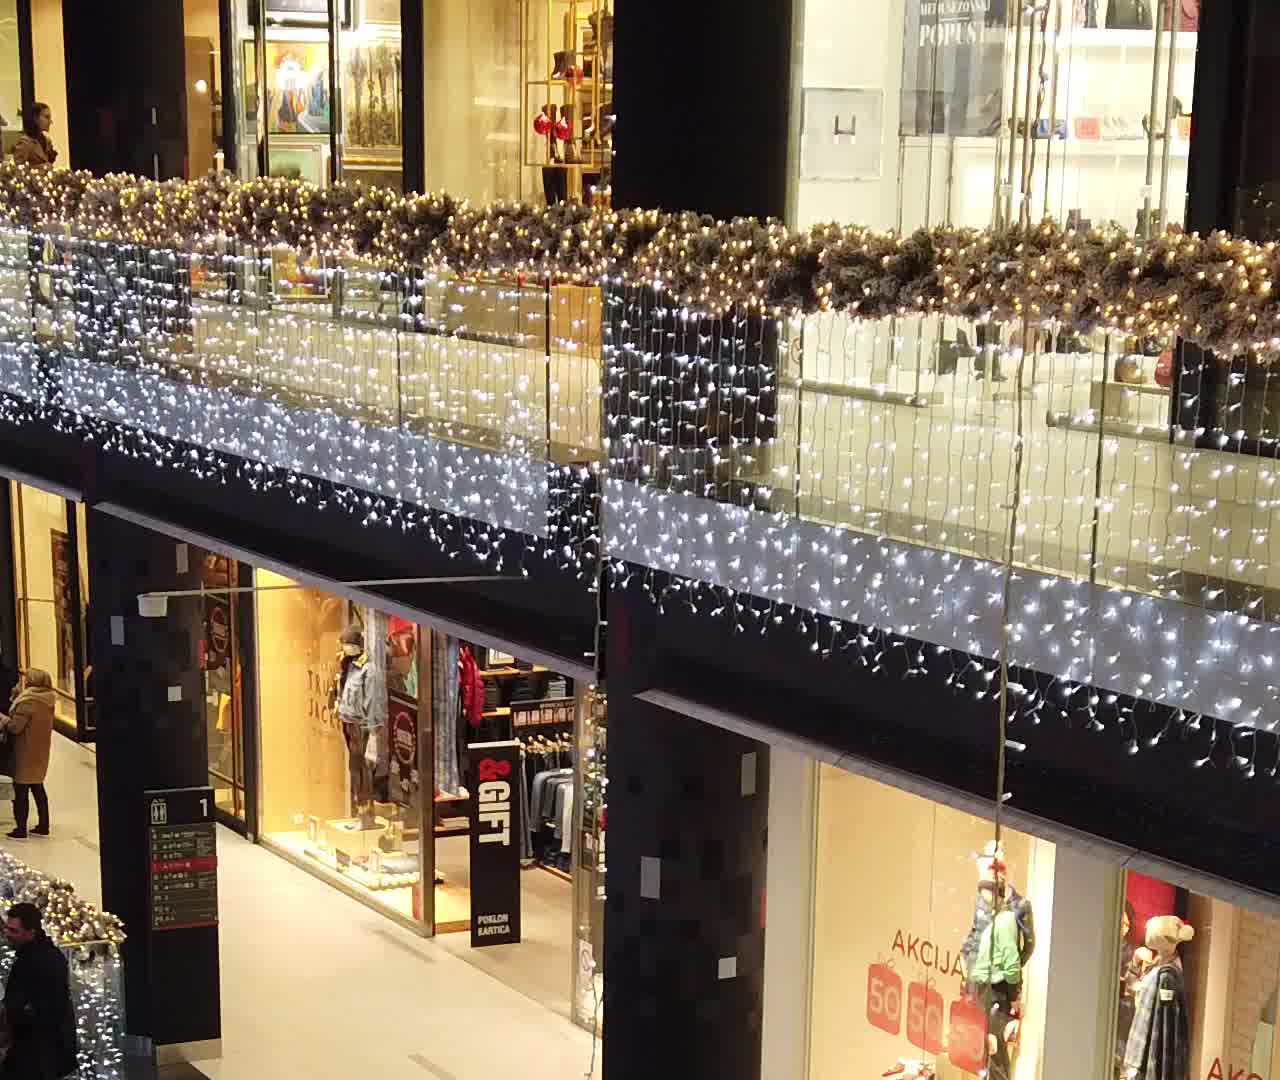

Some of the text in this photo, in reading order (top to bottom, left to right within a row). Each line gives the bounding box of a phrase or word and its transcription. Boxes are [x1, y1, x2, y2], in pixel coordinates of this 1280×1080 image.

[199, 798, 208, 817] 1
[892, 928, 965, 981] AKCIJA
[870, 975, 899, 1020] 50
